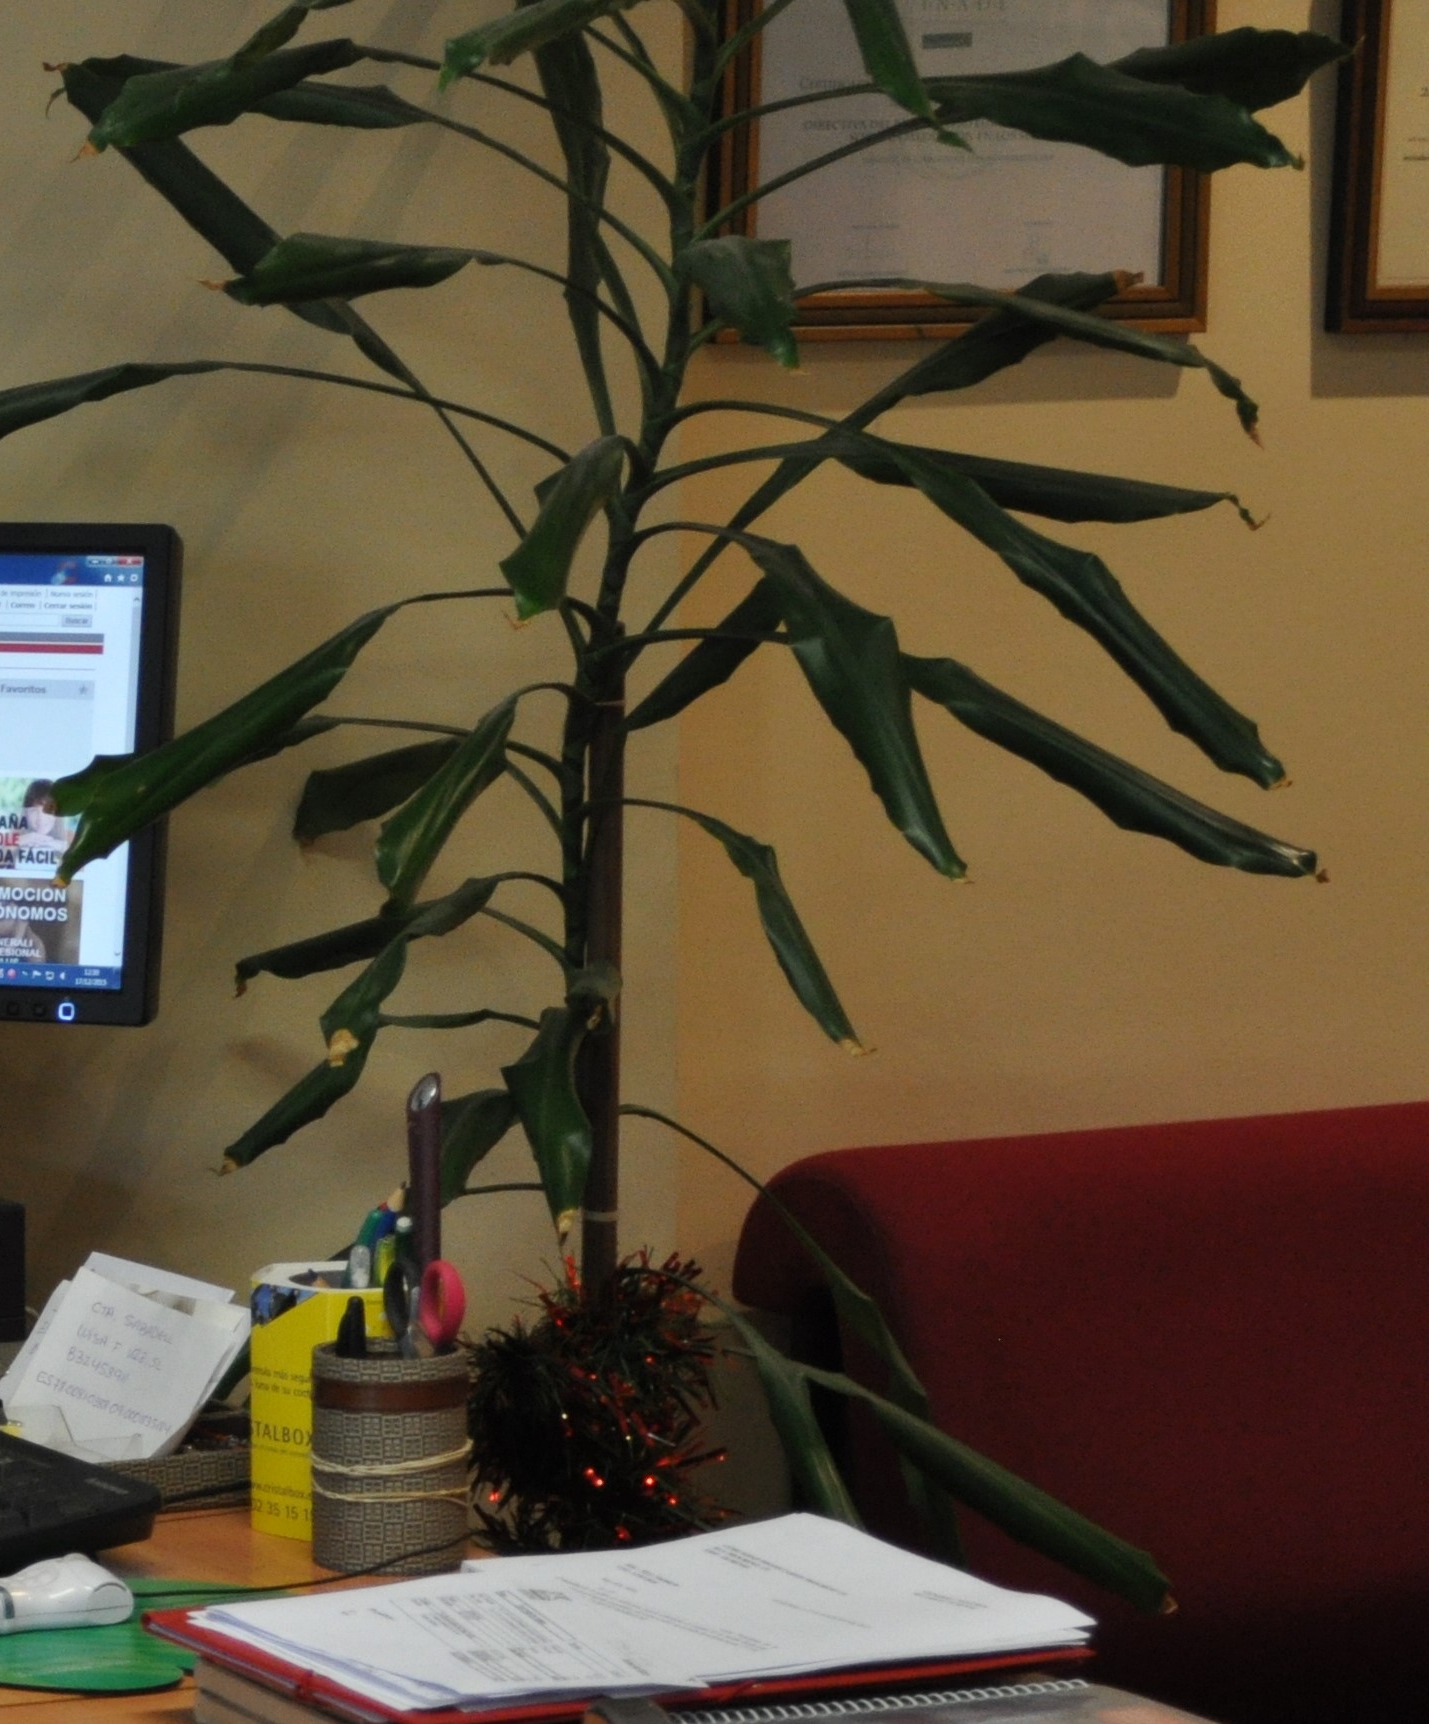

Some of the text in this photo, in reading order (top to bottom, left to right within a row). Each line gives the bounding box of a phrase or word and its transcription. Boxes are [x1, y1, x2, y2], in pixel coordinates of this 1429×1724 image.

[0, 684, 47, 694] Favoritos
[18, 847, 58, 865] FÁCIL
[267, 1501, 299, 1520] 35 15
